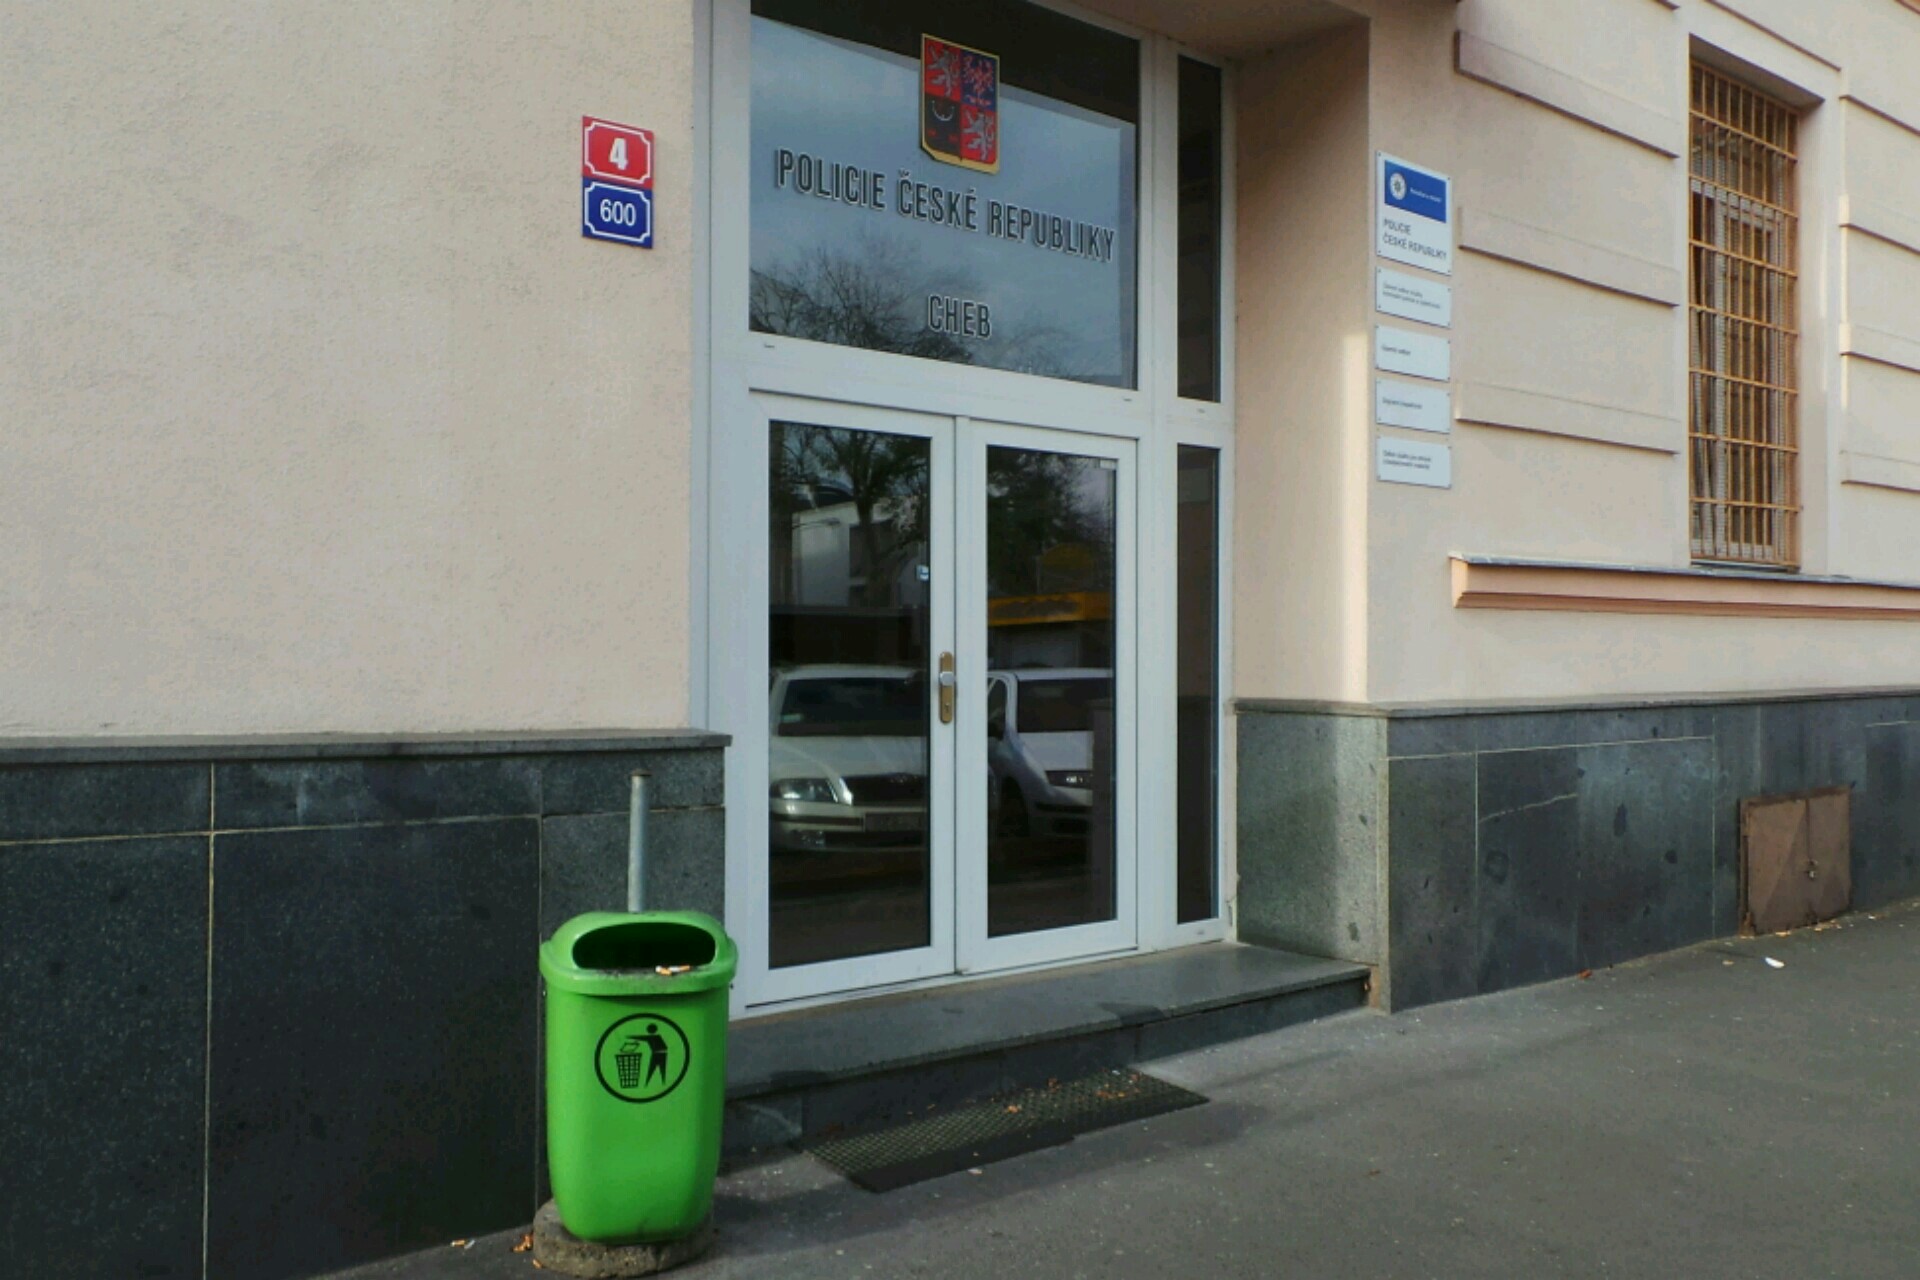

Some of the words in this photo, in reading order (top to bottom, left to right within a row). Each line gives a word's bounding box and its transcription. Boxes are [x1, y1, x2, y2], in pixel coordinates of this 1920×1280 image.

[608, 138, 628, 170] 4
[600, 199, 636, 226] 600
[777, 148, 886, 211] POLICIE
[898, 168, 978, 232] ČESKÉ
[988, 199, 1116, 262] REPUBLIKY
[928, 294, 992, 340] CHEB
